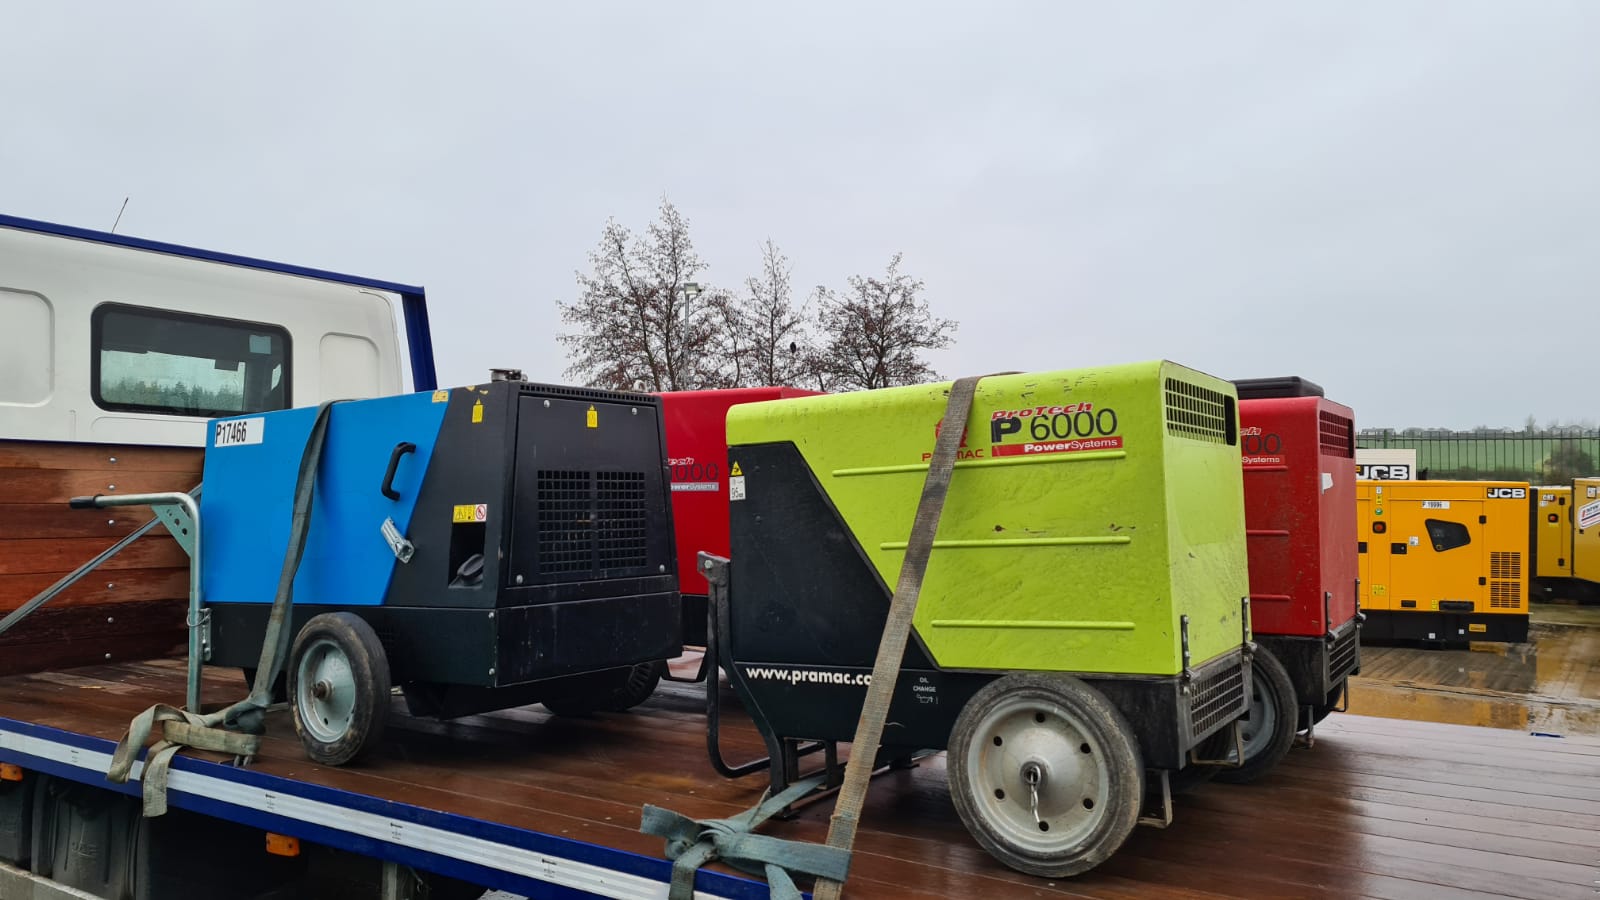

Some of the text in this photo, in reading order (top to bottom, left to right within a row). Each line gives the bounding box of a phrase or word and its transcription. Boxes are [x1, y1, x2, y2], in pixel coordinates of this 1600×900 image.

[215, 421, 247, 445] P17466
[991, 408, 1118, 443] P 6000
[1024, 439, 1118, 453] PowerSystems
[1245, 433, 1282, 454] 00
[921, 448, 985, 461] PMAC
[674, 463, 719, 481] 000
[1356, 465, 1409, 480] JCB
[1487, 488, 1525, 498] JCB
[746, 667, 873, 685] www.pramac.co
